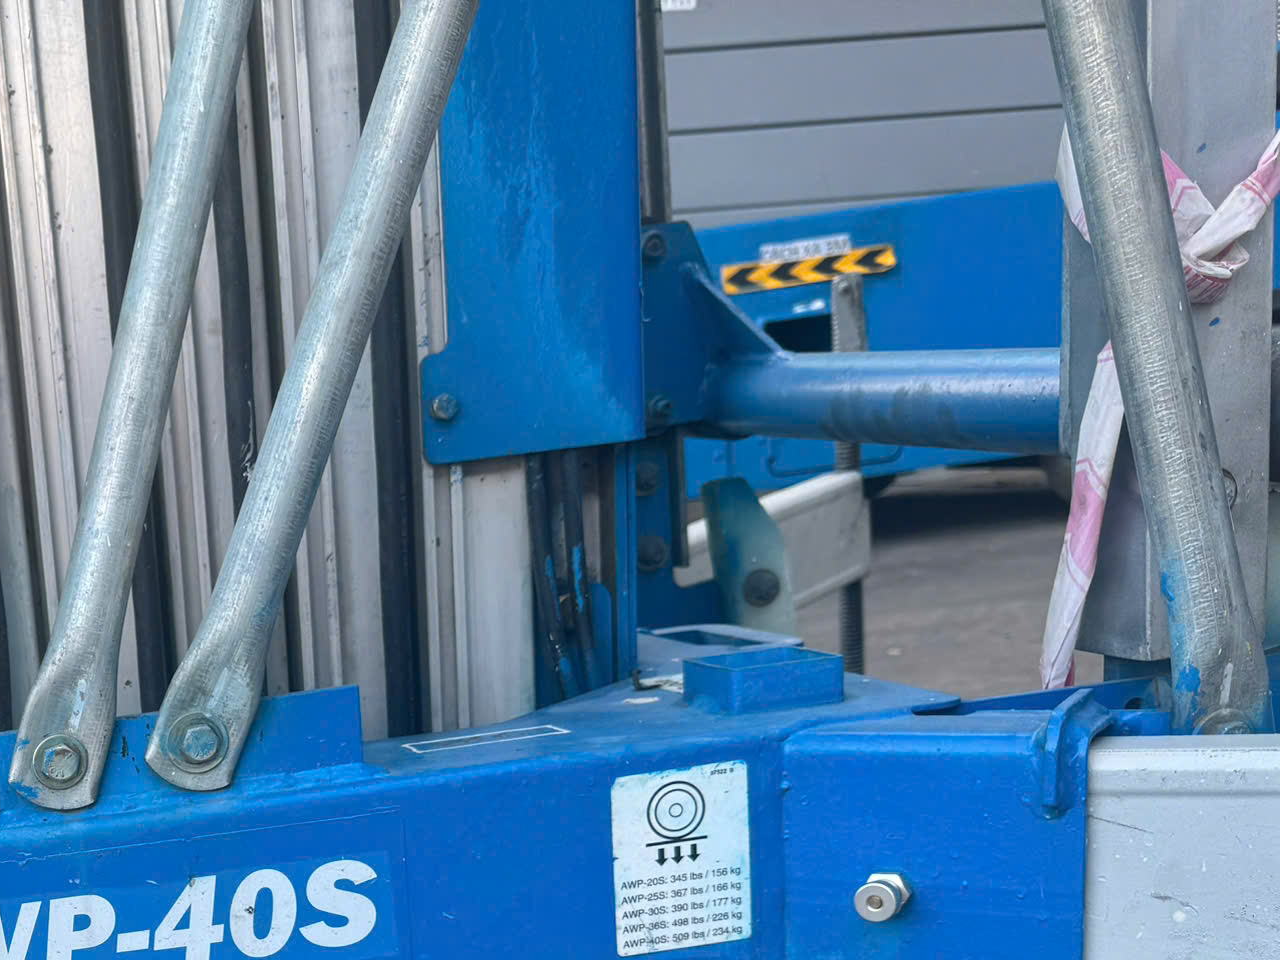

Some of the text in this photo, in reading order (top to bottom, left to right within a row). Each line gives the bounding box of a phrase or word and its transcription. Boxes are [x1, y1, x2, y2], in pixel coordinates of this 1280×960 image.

[621, 876, 668, 890] AWP-20S:
[670, 873, 688, 883] 345
[690, 872, 703, 881] lbs
[712, 867, 728, 877] 156
[730, 866, 741, 876] kg
[621, 891, 668, 905] AWP-25S:
[670, 888, 688, 898] 367
[690, 887, 704, 895] lbs
[712, 882, 728, 892] 166
[730, 881, 741, 891] kg
[622, 905, 669, 920] AWP-30S:
[671, 903, 688, 913] 390
[690, 902, 704, 910] lbs
[712, 897, 728, 907] 177
[731, 896, 742, 906] kg
[622, 920, 669, 935] AWP-36S:
[672, 918, 689, 927] 498
[712, 912, 729, 922] 226
[731, 911, 742, 920] kg
[623, 935, 670, 949] AWP-40S:
[672, 932, 689, 943] 509
[691, 931, 705, 939] lbs
[712, 927, 729, 936] 234
[732, 926, 743, 935] kg
